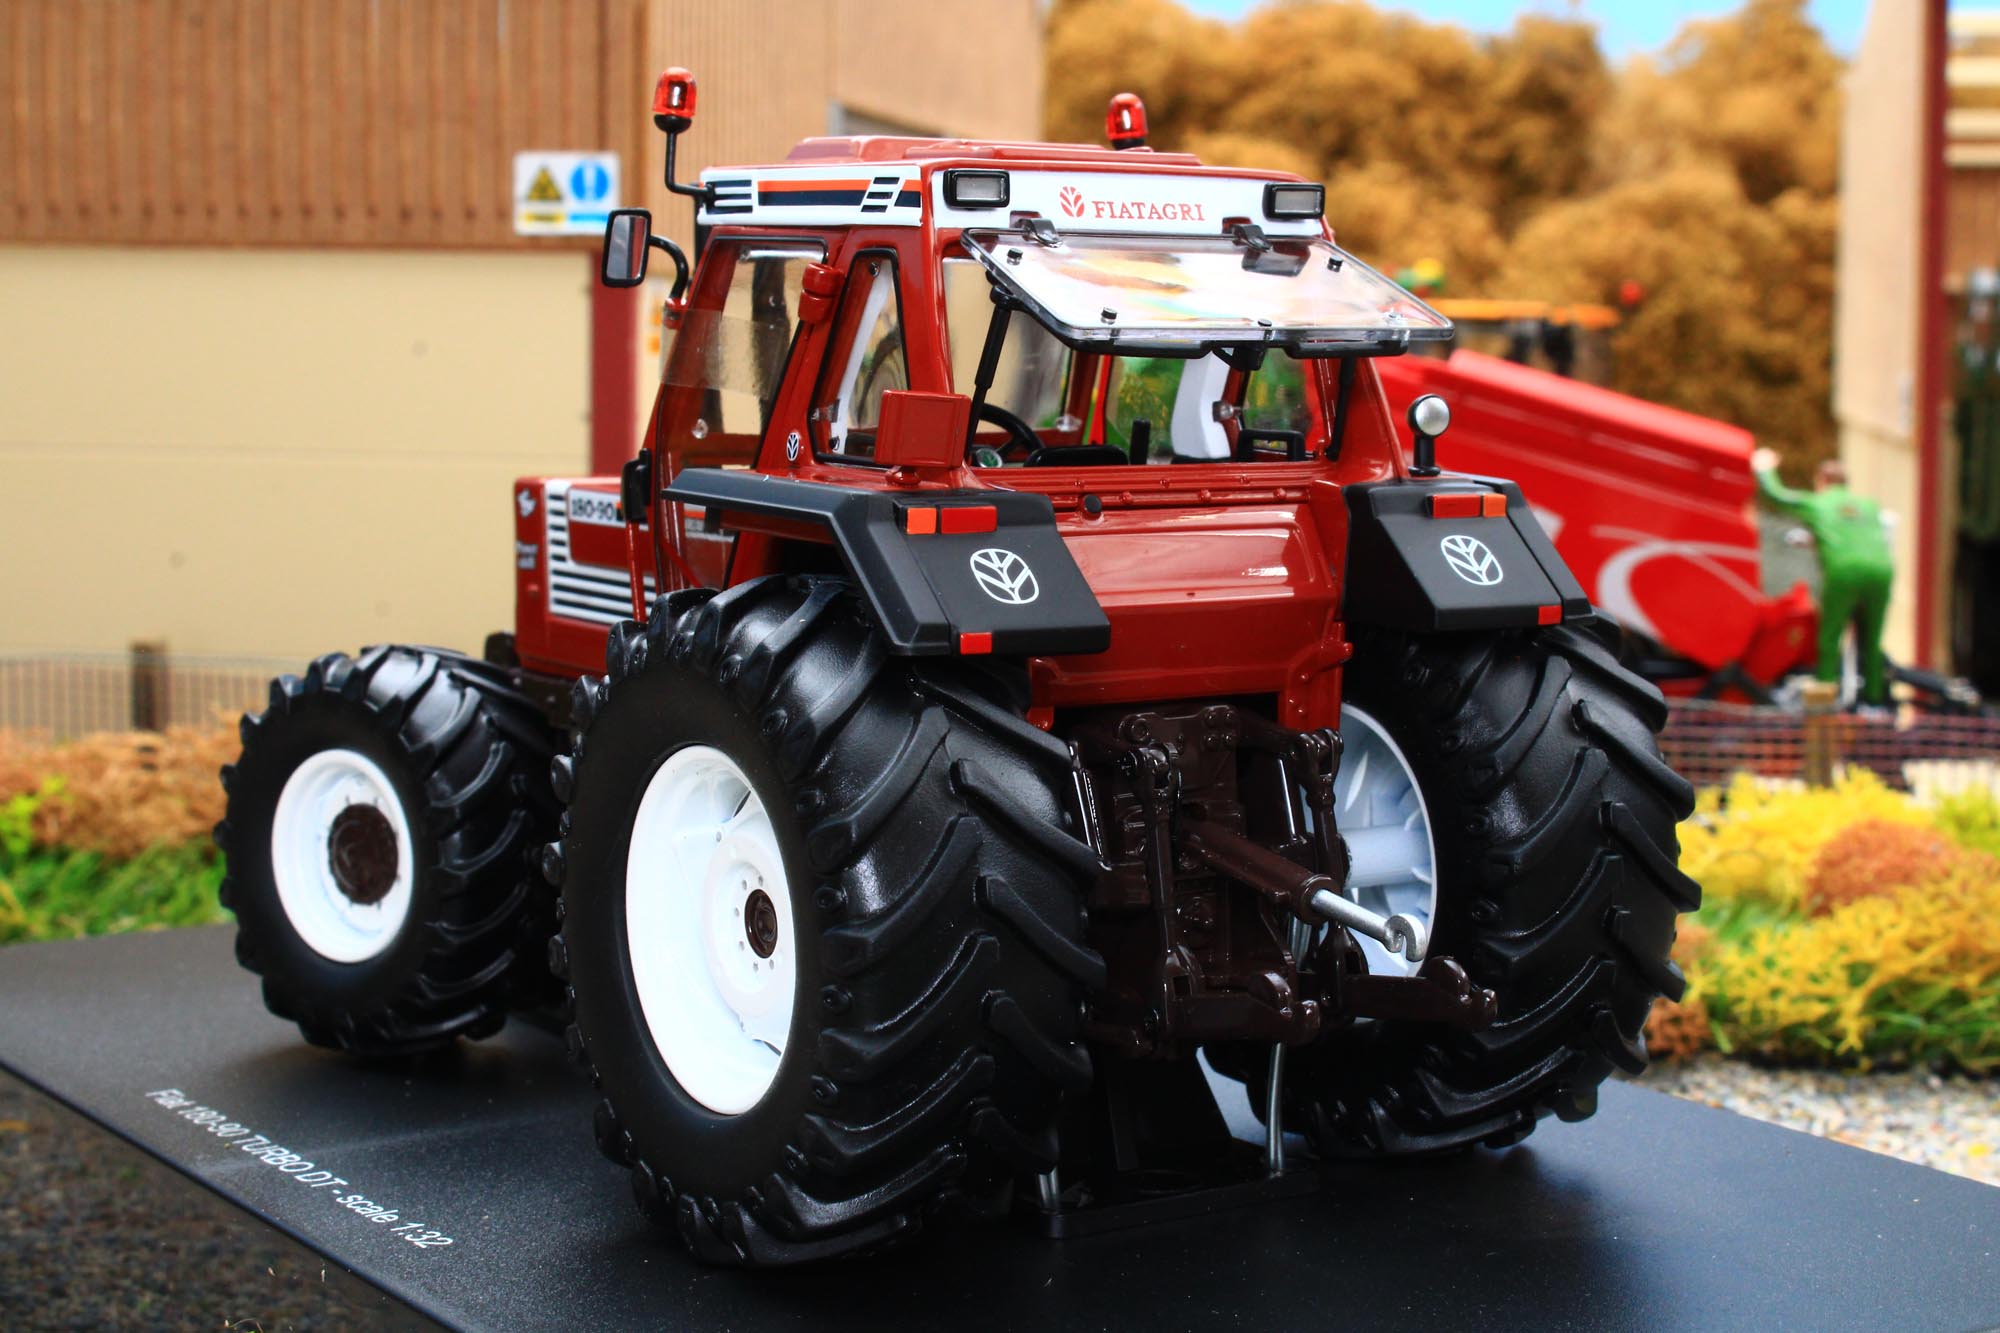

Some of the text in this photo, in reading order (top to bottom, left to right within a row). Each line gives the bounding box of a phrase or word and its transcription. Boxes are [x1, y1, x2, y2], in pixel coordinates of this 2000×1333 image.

[1092, 200, 1205, 221] FIATAGRI
[572, 498, 614, 520] 180-90
[145, 1088, 196, 1109] Fiat
[177, 1106, 250, 1137] 180-90
[232, 1134, 314, 1173] TURBO
[295, 1170, 348, 1188] DT
[336, 1194, 399, 1224] scale
[390, 1222, 453, 1249] 1:32
